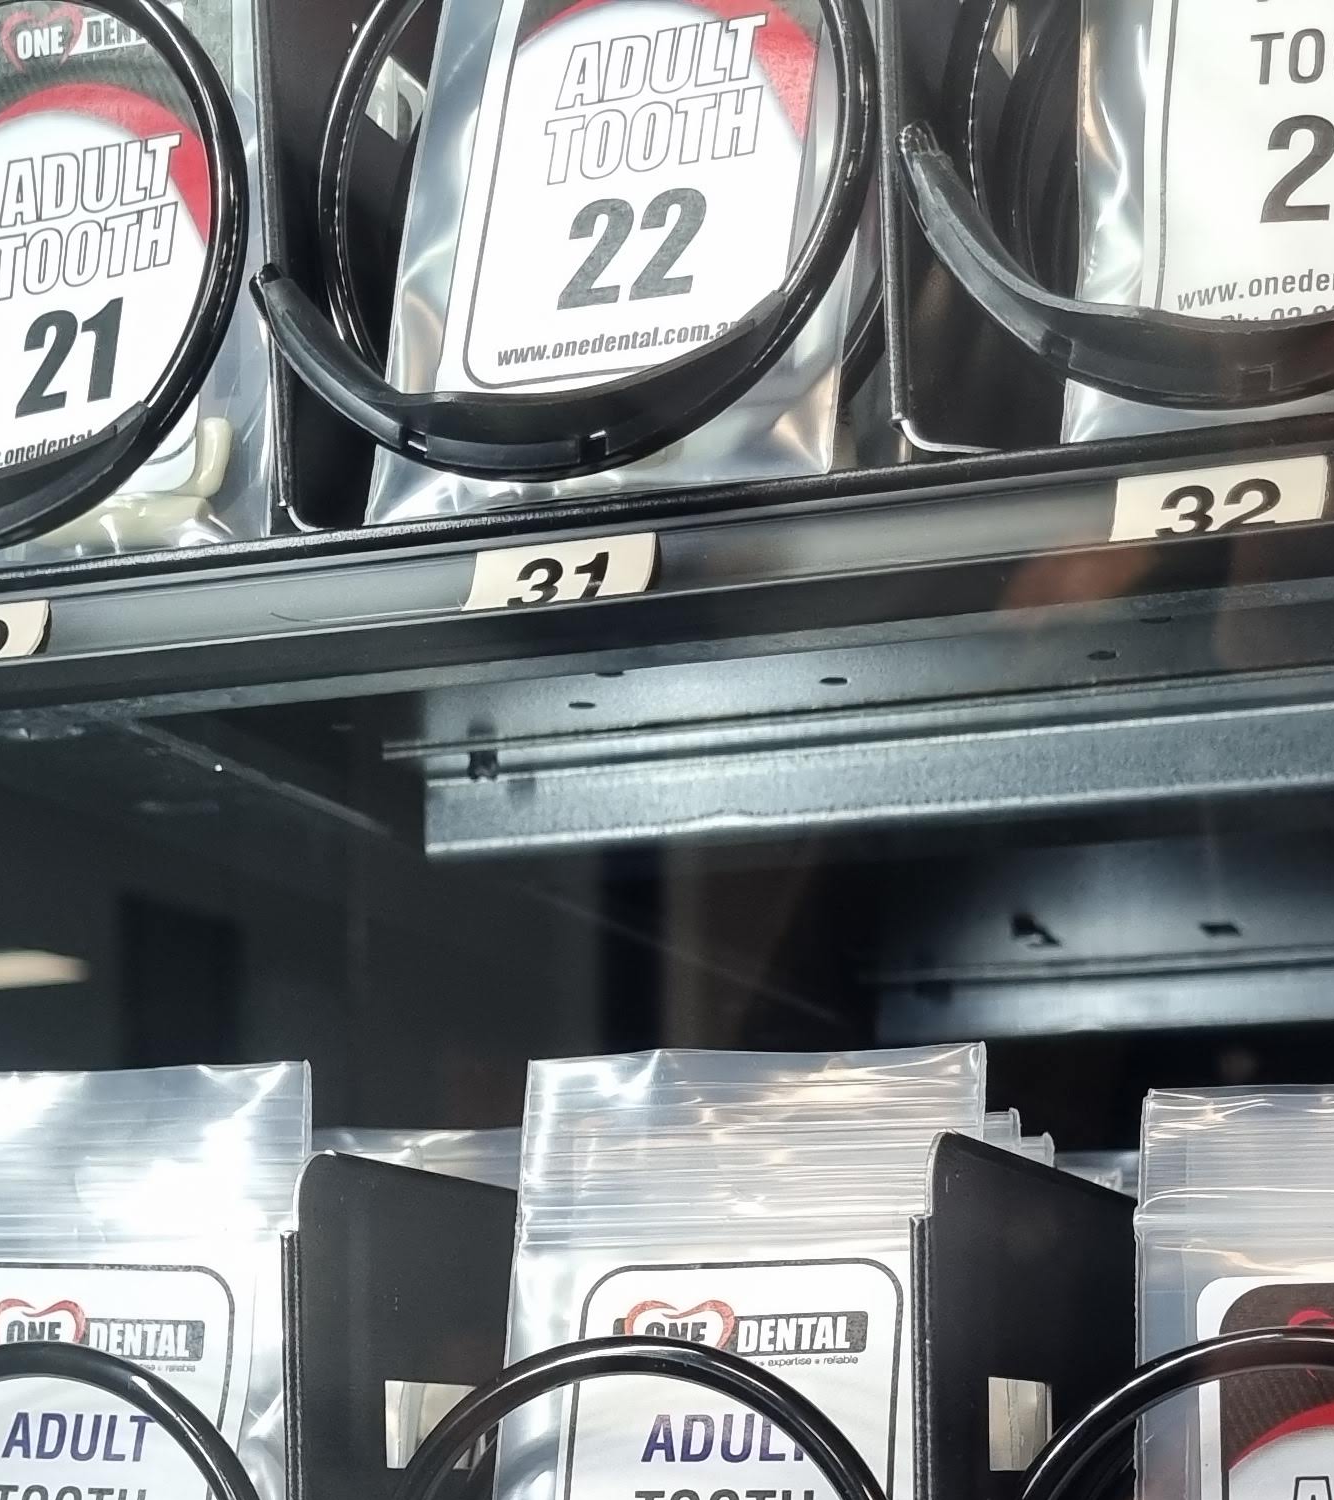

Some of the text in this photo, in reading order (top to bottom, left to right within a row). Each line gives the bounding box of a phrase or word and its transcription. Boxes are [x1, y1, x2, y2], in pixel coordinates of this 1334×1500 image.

[17, 26, 64, 60] ONE
[555, 14, 767, 111] ADULT
[544, 84, 765, 186] TOOTH
[0, 133, 182, 229] ADULT
[556, 187, 707, 311] 22
[15, 297, 124, 419] 21
[497, 319, 742, 367] www.onedental.com.a
[1155, 478, 1282, 540] 32
[507, 551, 610, 608] 31
[88, 1321, 189, 1359] DENTAL
[737, 1315, 852, 1354] DENTAL
[1, 1411, 156, 1463] ADULT
